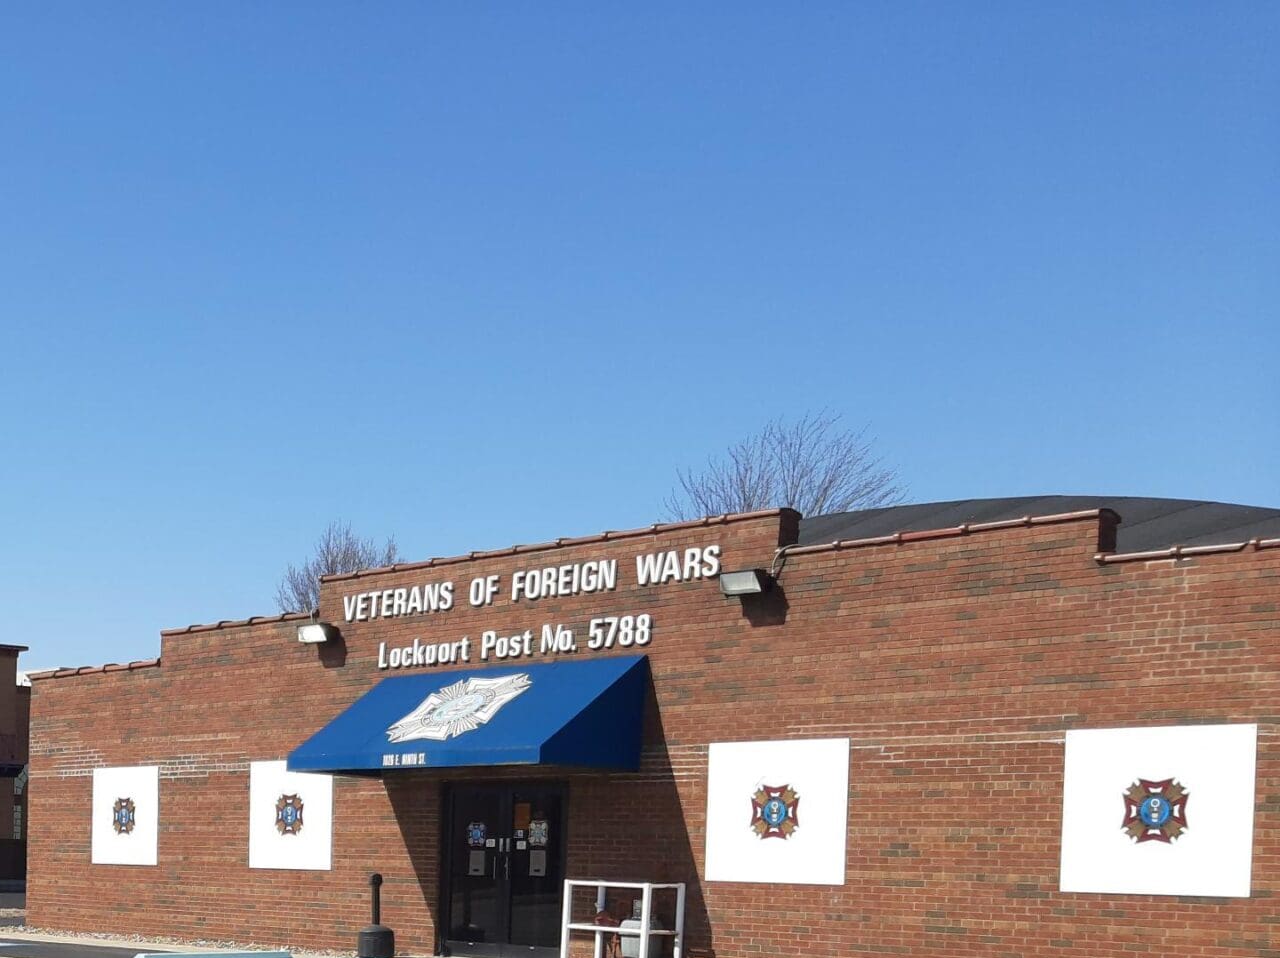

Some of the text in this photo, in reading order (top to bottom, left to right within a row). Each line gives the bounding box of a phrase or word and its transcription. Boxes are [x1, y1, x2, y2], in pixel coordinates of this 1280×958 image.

[343, 545, 720, 621] VETERANS OF FOREIGN WARS
[481, 629, 533, 659] Post
[540, 624, 577, 653] No.
[588, 614, 651, 648] 5788
